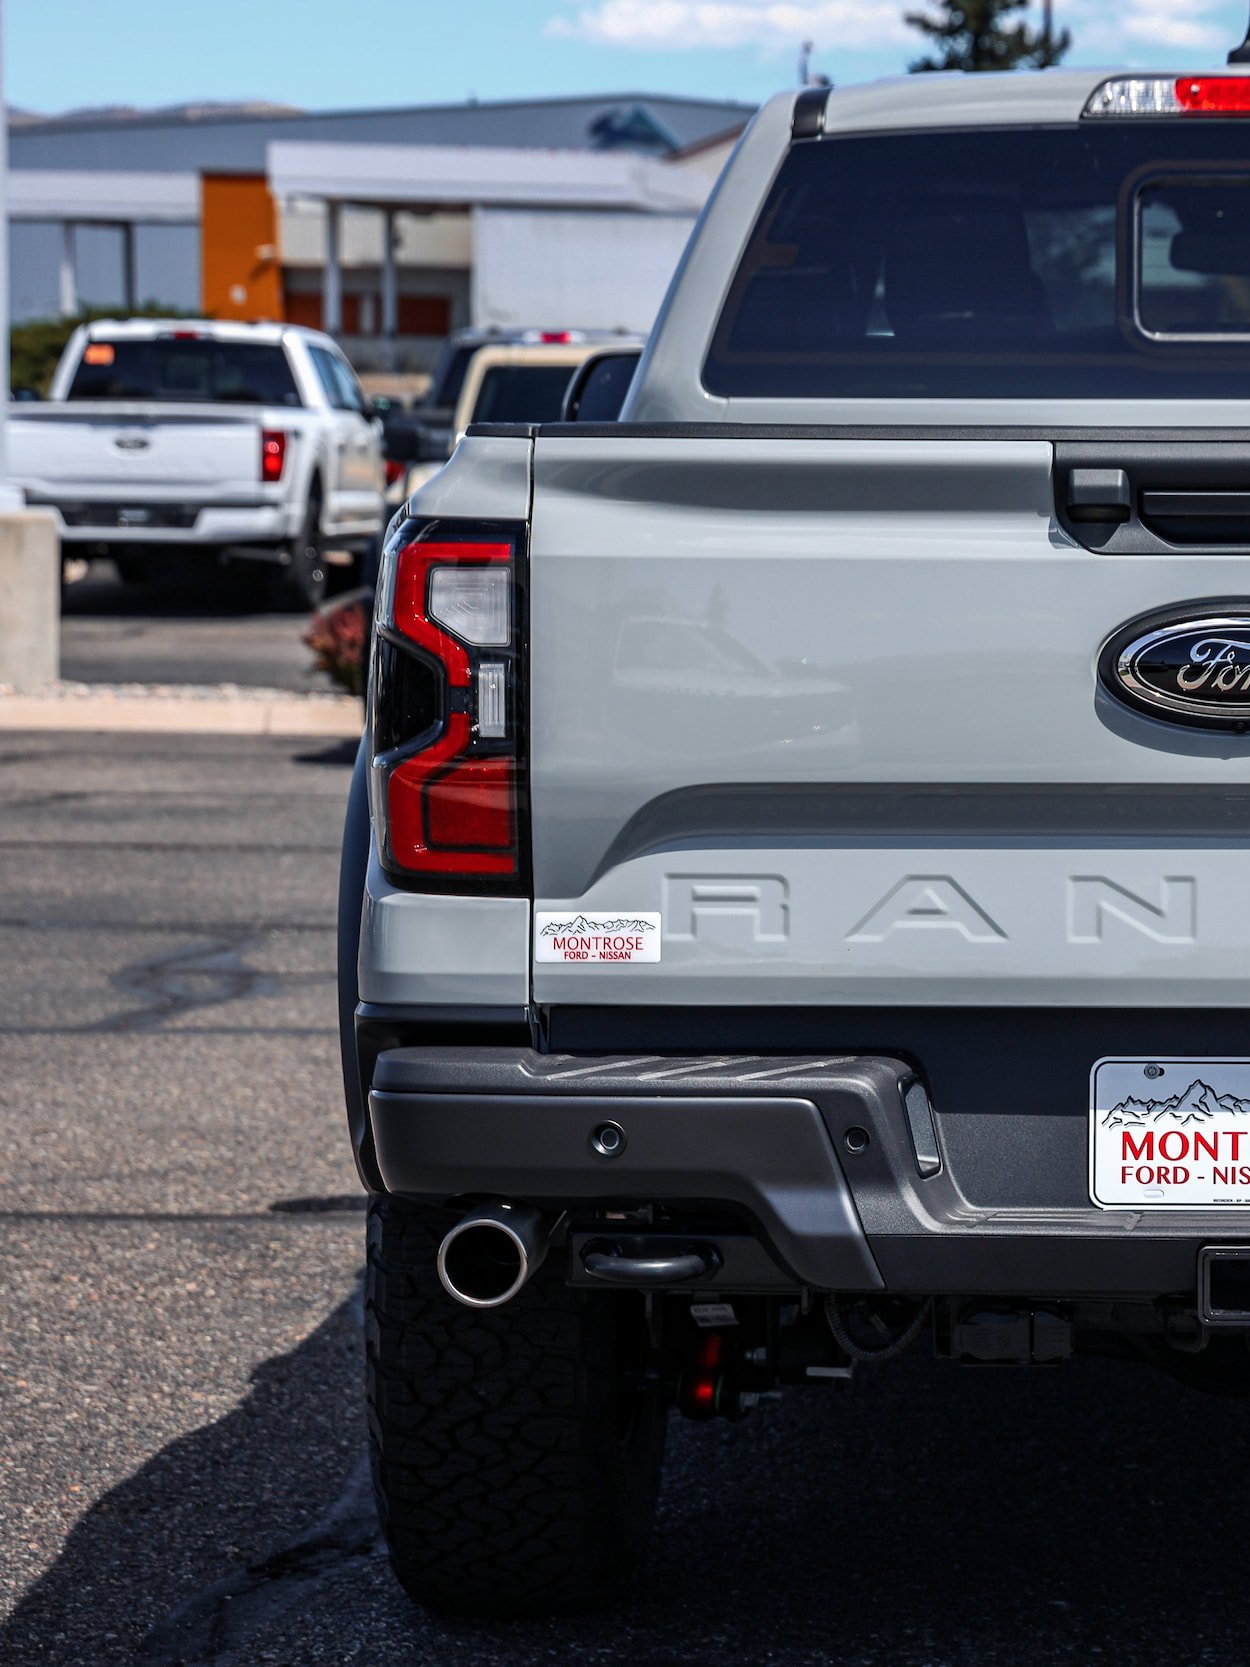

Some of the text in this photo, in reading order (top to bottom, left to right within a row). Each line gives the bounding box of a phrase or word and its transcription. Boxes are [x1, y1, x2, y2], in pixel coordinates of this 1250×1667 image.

[553, 936, 644, 950] MONTROSE
[564, 951, 588, 960] FORD
[599, 951, 631, 960] NISSAN
[1121, 1166, 1190, 1185] FORD
